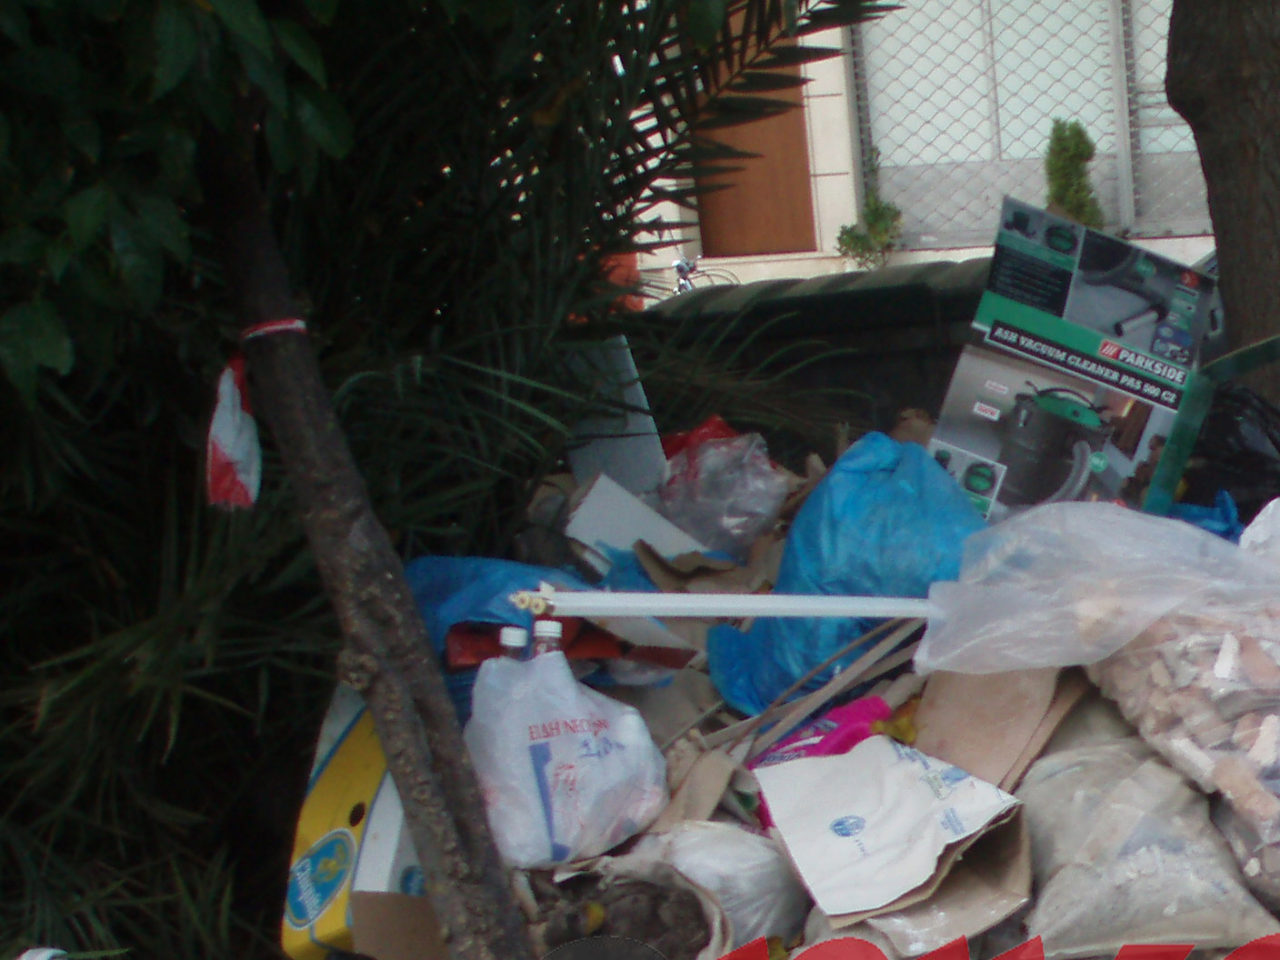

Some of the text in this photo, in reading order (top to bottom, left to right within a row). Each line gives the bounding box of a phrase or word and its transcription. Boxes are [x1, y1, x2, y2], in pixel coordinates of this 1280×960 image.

[994, 327, 1019, 344] ASH
[1020, 335, 1067, 363] VACUUM
[1067, 353, 1120, 385] CLEANER
[1118, 349, 1187, 385] PARKSIDE
